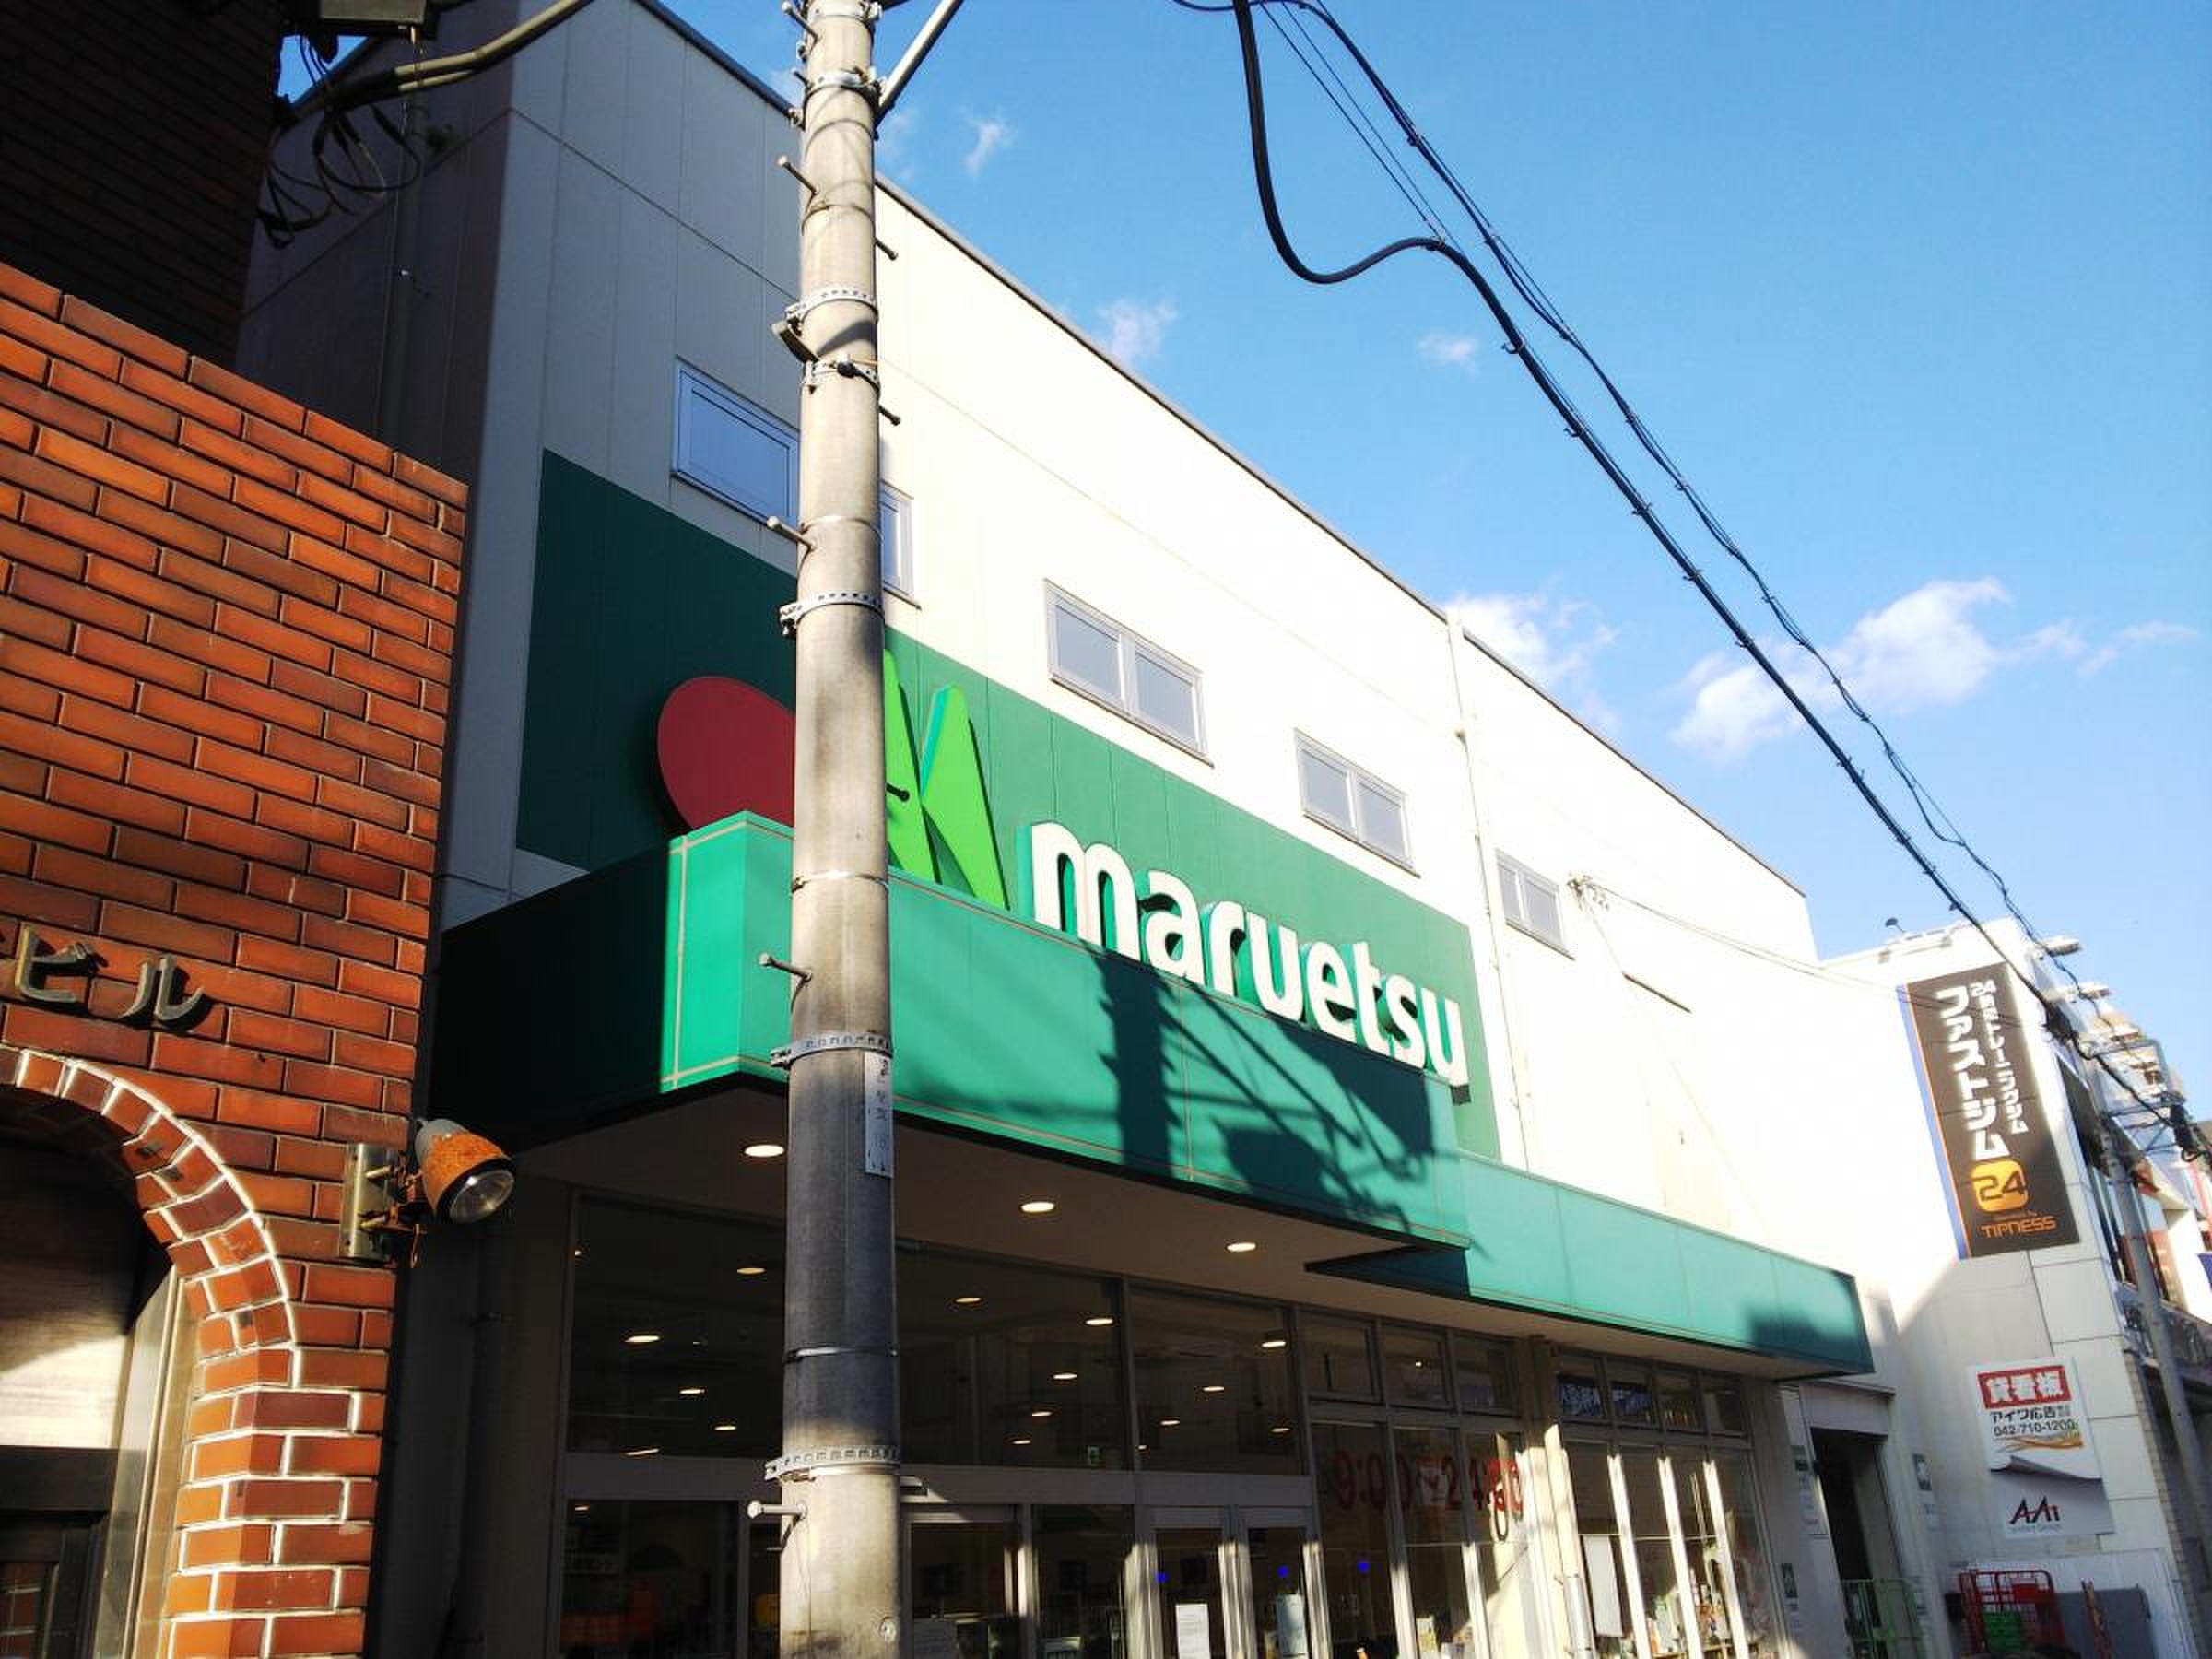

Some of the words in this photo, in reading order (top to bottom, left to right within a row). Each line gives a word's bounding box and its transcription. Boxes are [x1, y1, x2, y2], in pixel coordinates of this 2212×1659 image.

[15, 922, 206, 1021] ビル
[1030, 822, 1468, 1086] maruetsu
[1935, 984, 2010, 1161] ファストジム
[1972, 1170, 2026, 1203] 24
[1981, 1216, 2057, 1238] TIPNESS
